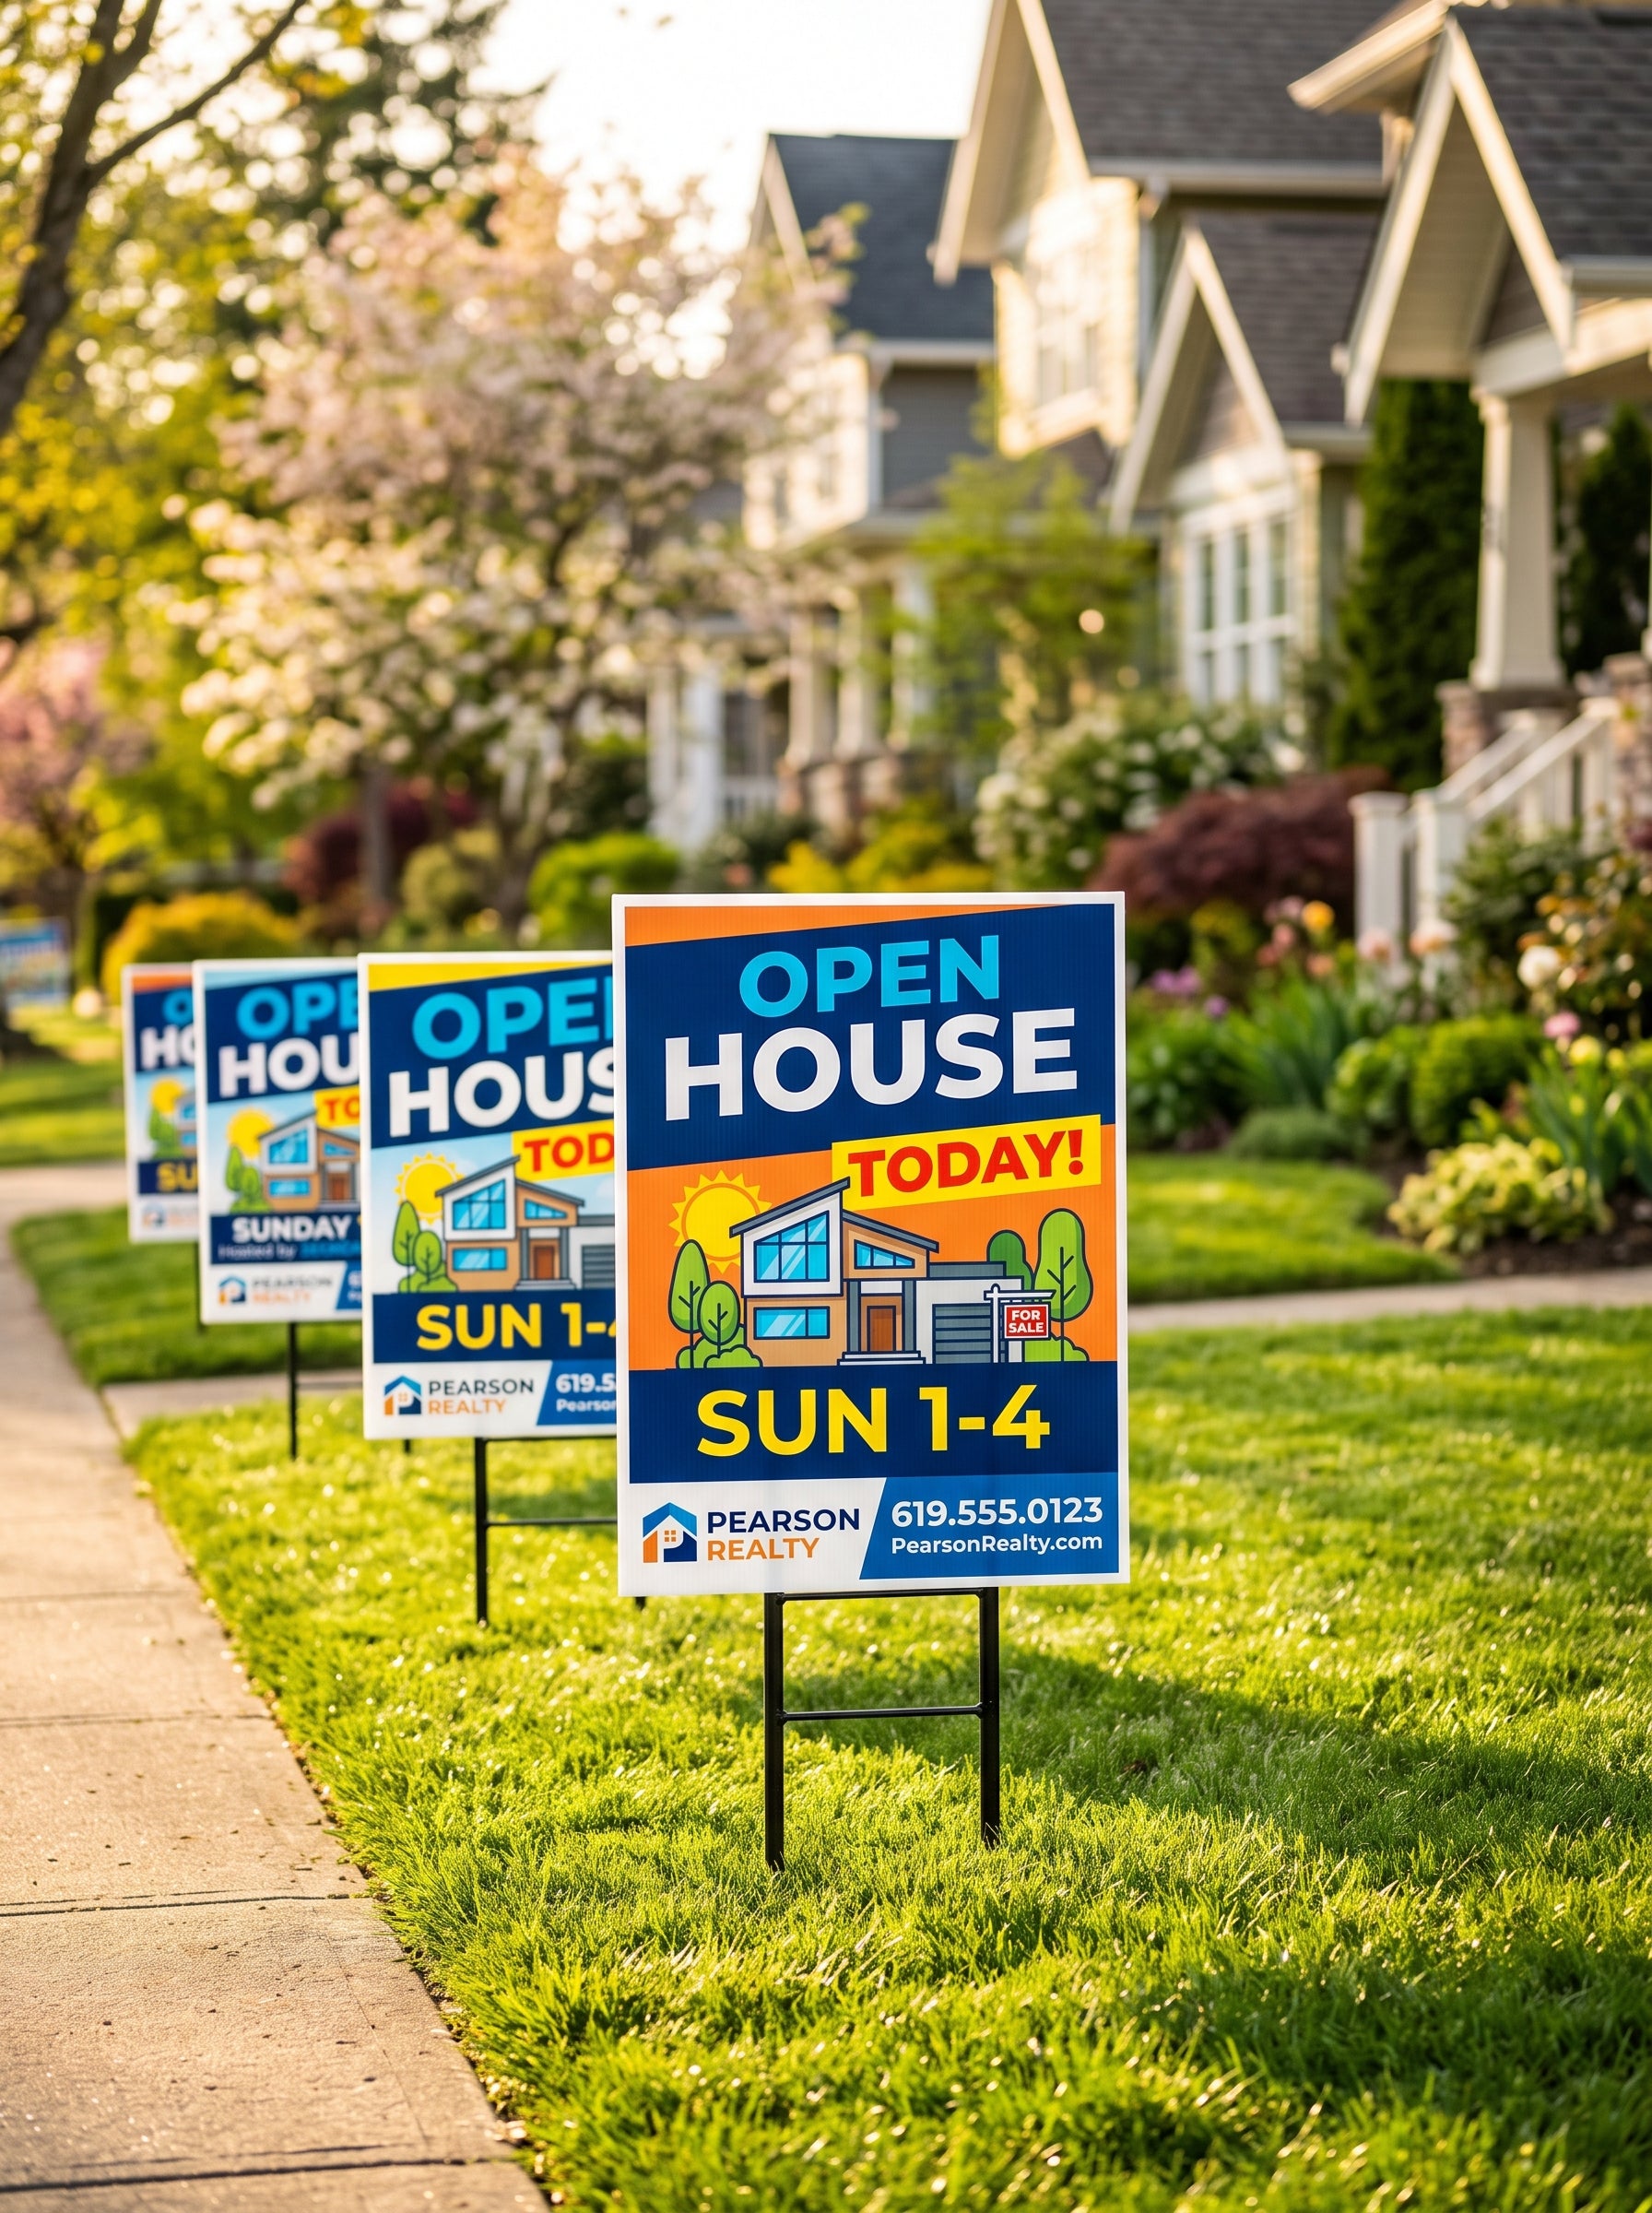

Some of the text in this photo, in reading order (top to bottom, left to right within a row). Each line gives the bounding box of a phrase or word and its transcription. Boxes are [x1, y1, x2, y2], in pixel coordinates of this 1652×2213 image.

[739, 934, 999, 1018] OPEN
[412, 976, 613, 1059] OPE
[218, 1033, 360, 1098] HOU
[665, 1007, 1078, 1122] HOUSE
[523, 1131, 614, 1172] TOD
[848, 1129, 1084, 1198] TODAY!
[231, 1215, 352, 1244] SUNDAY
[417, 1302, 616, 1351] SUN 1-
[1009, 1322, 1044, 1333] SALE
[1011, 1309, 1040, 1320] FOR
[429, 1379, 534, 1395] PEARSON
[429, 1399, 506, 1414] REALTY
[697, 1384, 1050, 1458] SUN 1-4
[707, 1508, 859, 1533] PEARSON
[891, 1497, 1103, 1527] 619.555.0123
[707, 1537, 820, 1561] REALTY
[891, 1533, 1103, 1556] PearsonRealty.com
